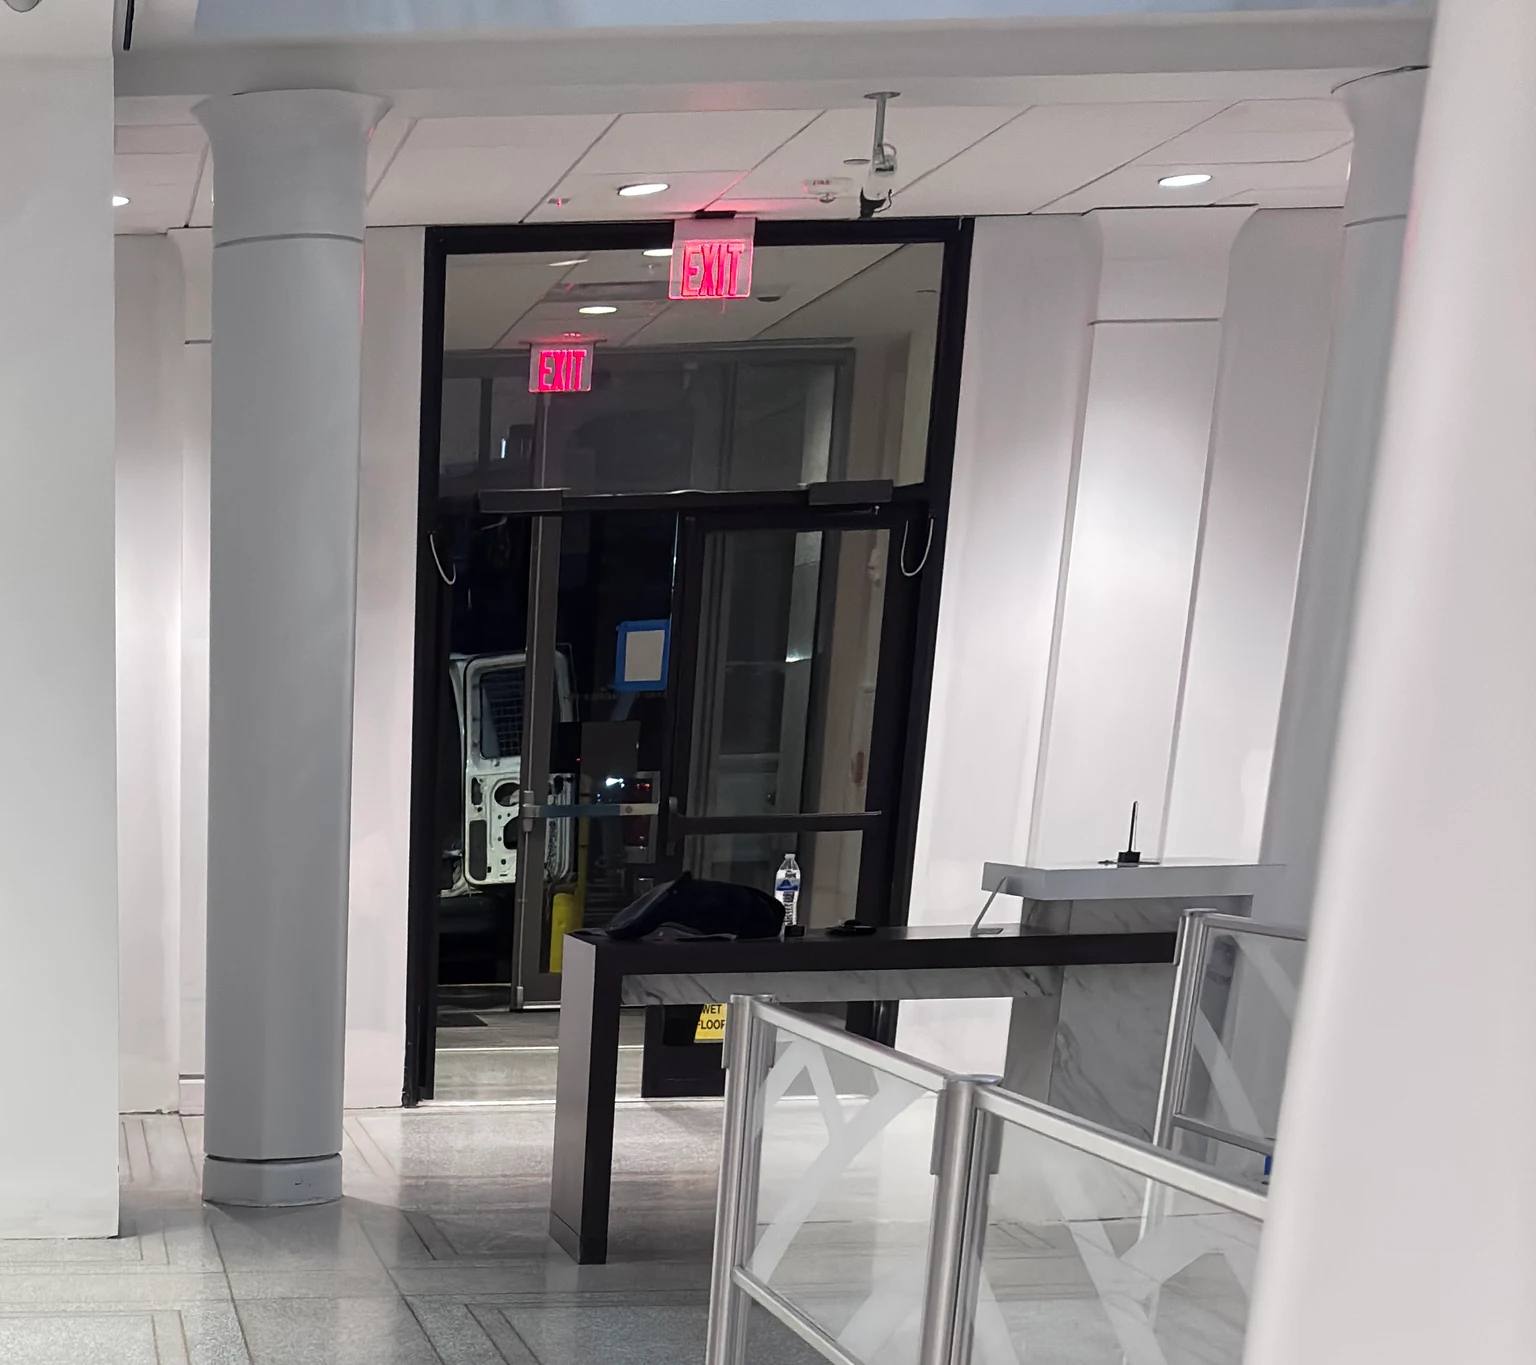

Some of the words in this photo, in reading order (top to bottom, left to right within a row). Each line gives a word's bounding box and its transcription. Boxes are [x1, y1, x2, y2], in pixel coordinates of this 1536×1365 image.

[681, 244, 744, 296] EXIT
[538, 350, 586, 390] EXIT
[696, 1019, 725, 1030] LOO
